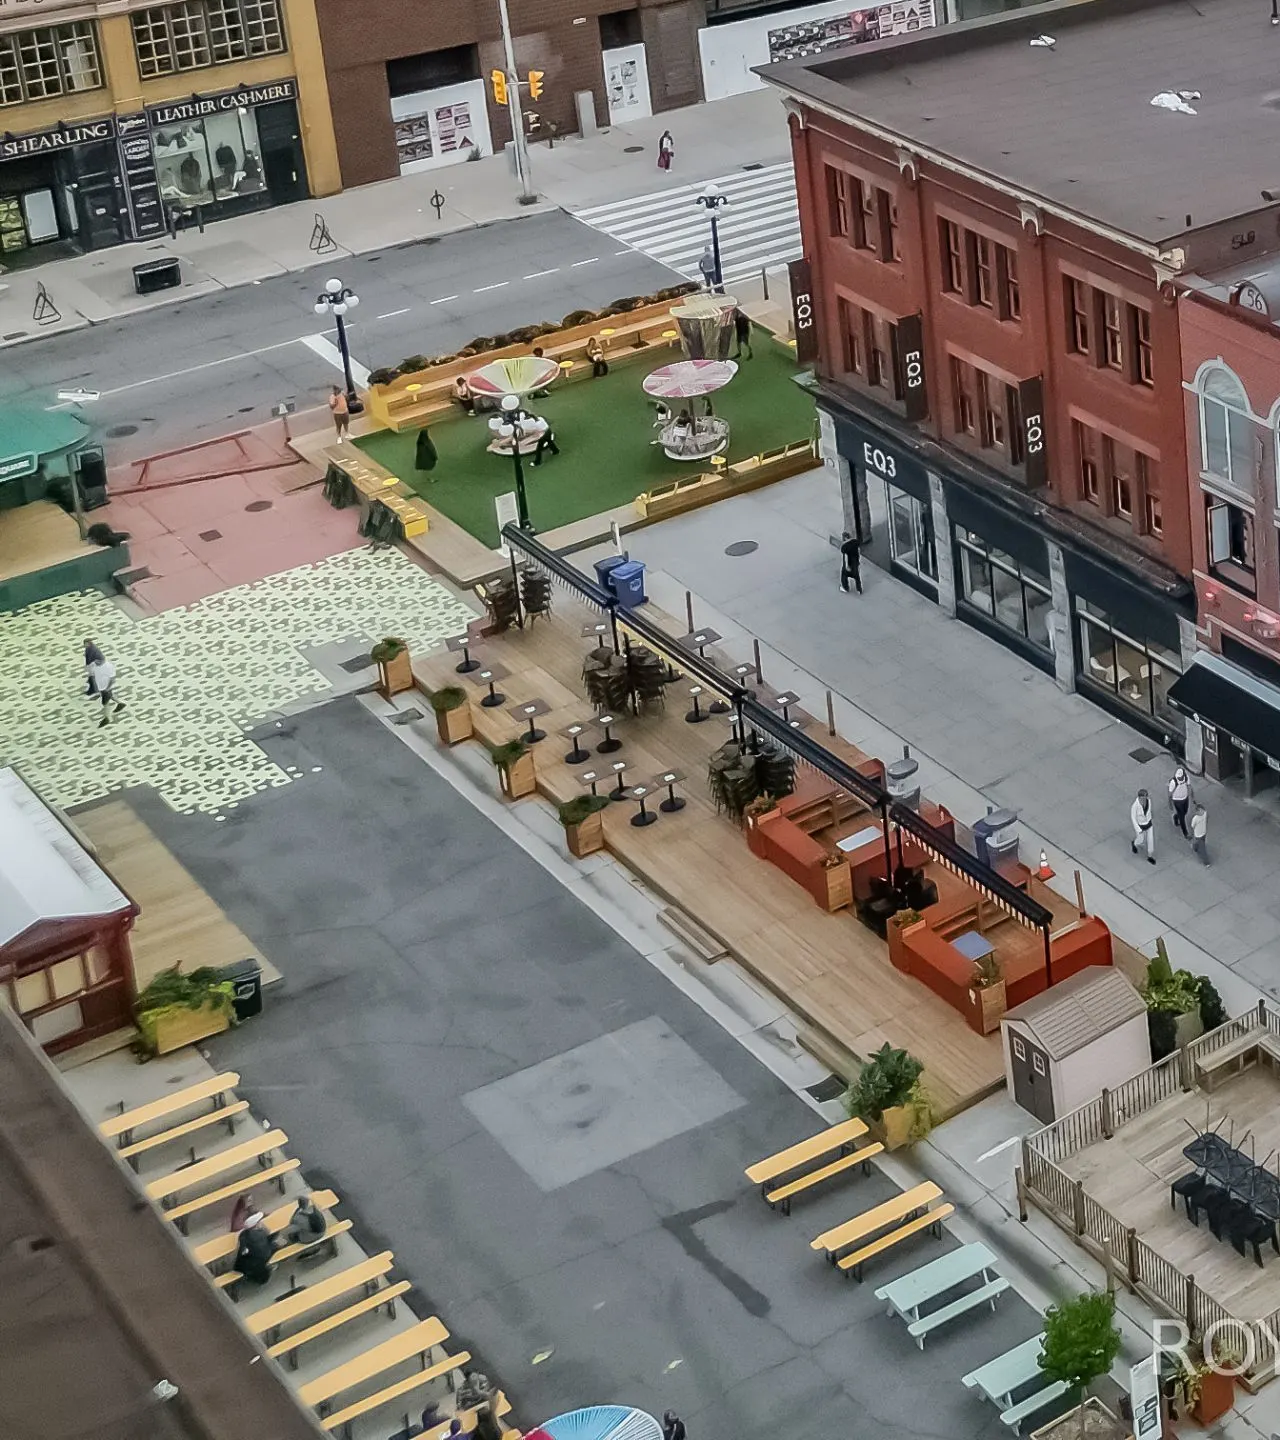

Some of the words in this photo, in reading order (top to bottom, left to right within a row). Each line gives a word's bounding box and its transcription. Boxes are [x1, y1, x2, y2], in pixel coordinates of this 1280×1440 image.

[156, 100, 216, 124] LEATHER
[220, 83, 292, 109] CASHMERE
[4, 123, 108, 157] SHEARLING
[796, 293, 812, 329] EQ3
[1246, 289, 1263, 311] 56
[905, 351, 922, 388] EQ3
[1026, 415, 1043, 453] EQ3
[863, 442, 897, 478] EQ3
